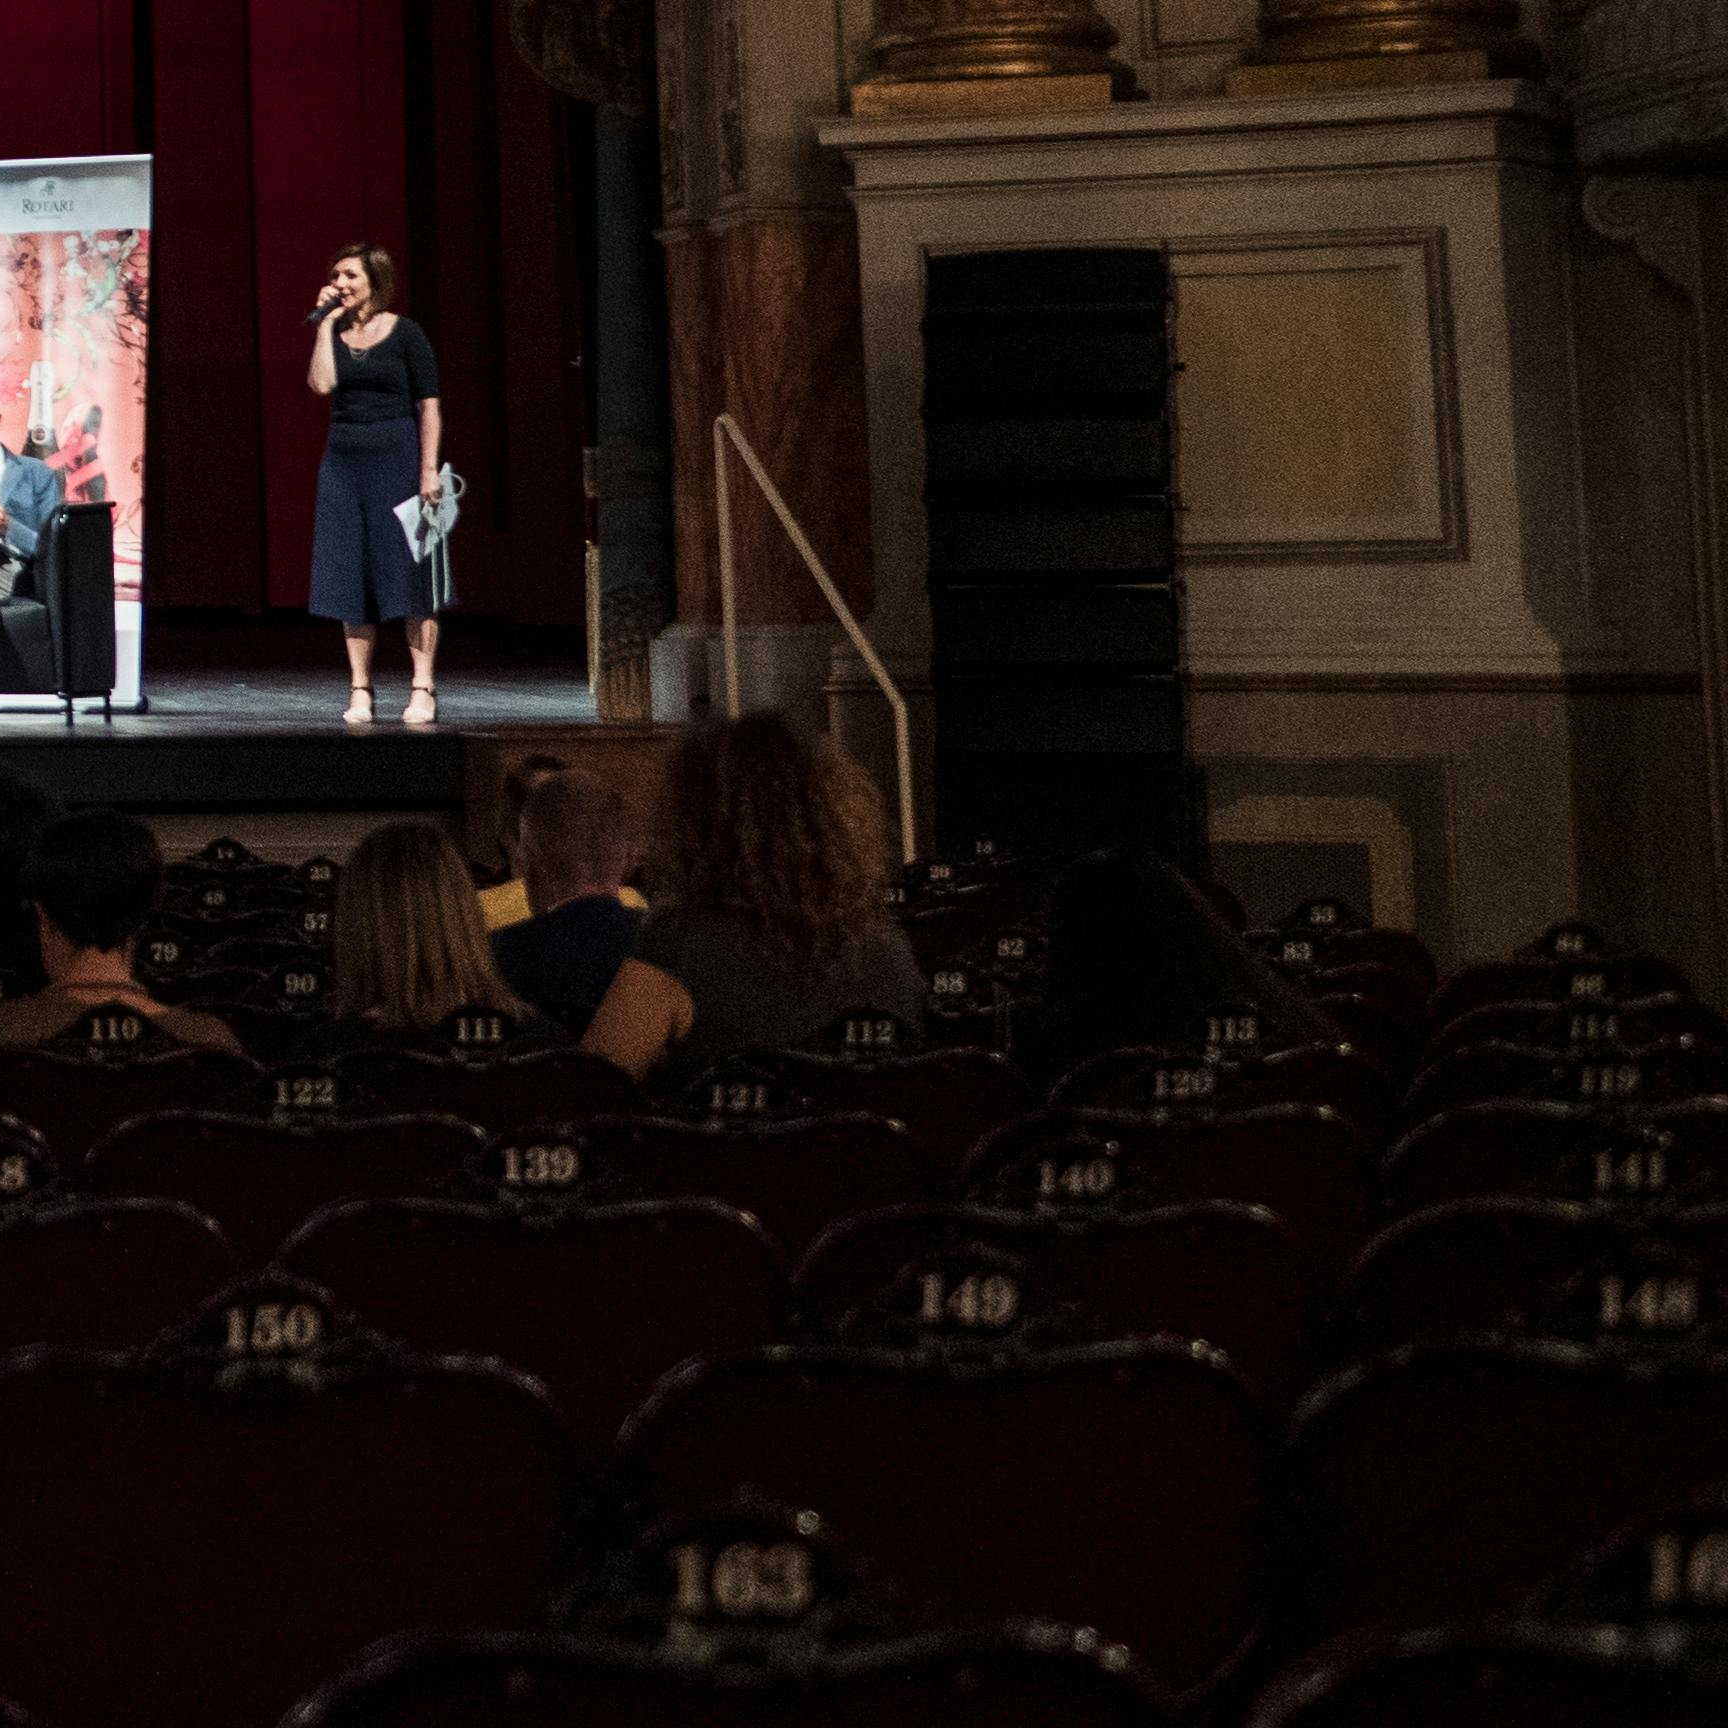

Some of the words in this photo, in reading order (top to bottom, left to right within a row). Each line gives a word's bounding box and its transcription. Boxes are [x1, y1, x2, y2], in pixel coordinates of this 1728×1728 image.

[284, 973, 317, 994] 90
[91, 1017, 141, 1042] 110
[457, 1017, 502, 1042] 111
[845, 1020, 893, 1045] 112
[276, 1078, 335, 1107] 122
[711, 1084, 766, 1112] 121
[505, 1146, 578, 1183] 139
[1039, 1161, 1113, 1196] 140
[921, 1274, 1018, 1324] 149
[1601, 1278, 1696, 1326] 148
[225, 1305, 320, 1352] 150
[676, 1545, 810, 1612] 163
